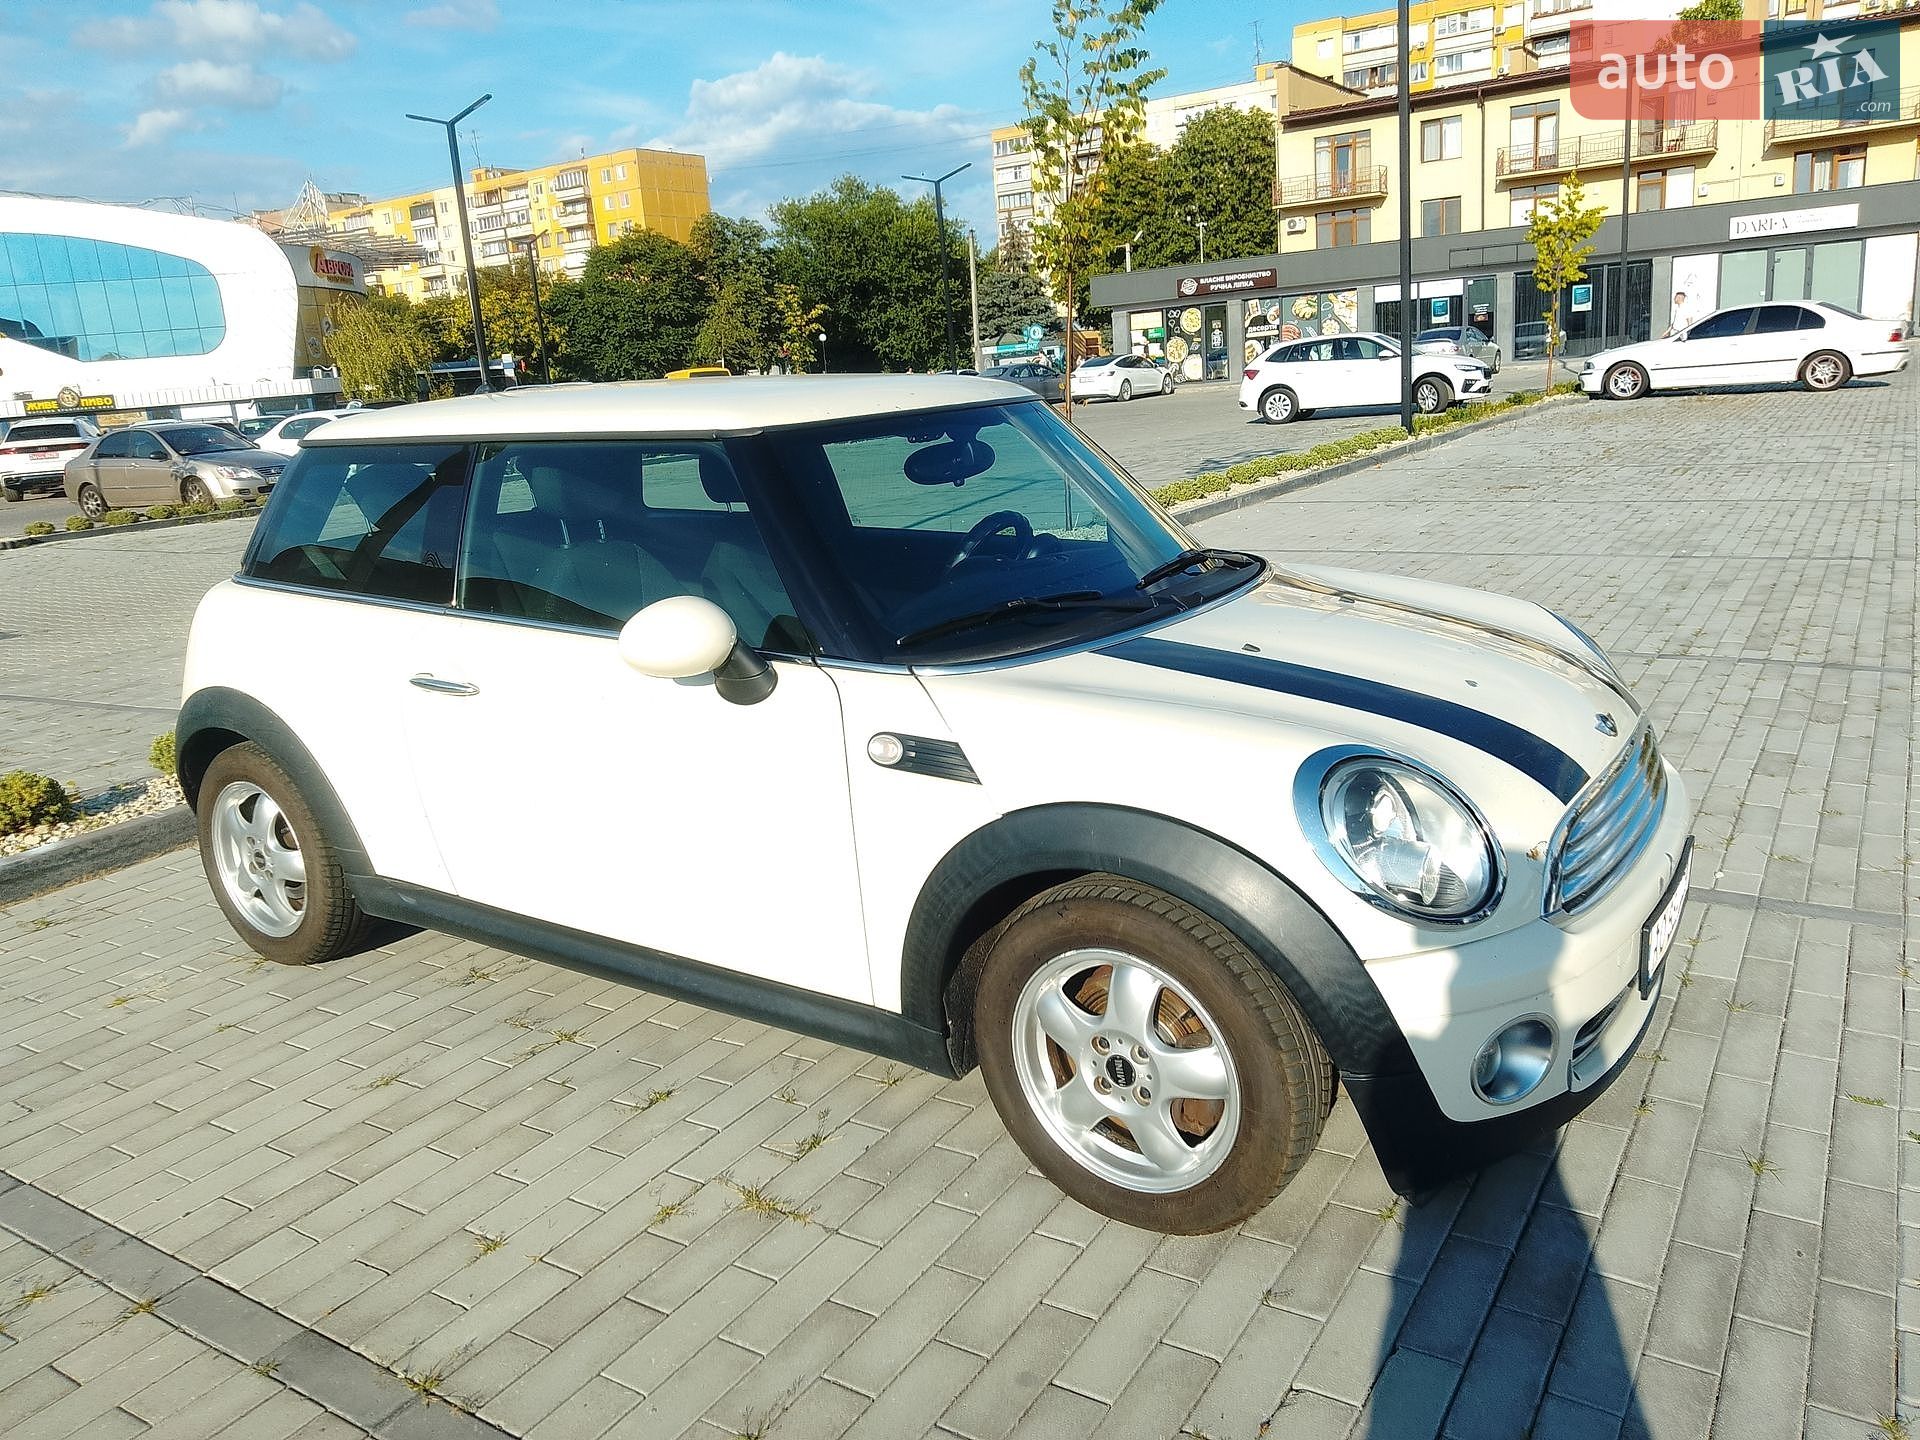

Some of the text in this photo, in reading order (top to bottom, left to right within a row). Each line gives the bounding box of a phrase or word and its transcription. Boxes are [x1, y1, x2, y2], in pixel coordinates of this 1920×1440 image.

[1200, 270, 1272, 284] ВЛАСНЕ ВИРОБНИЦТВО
[26, 401, 59, 411] ЖИВЕ
[81, 397, 112, 407] ПИВО
